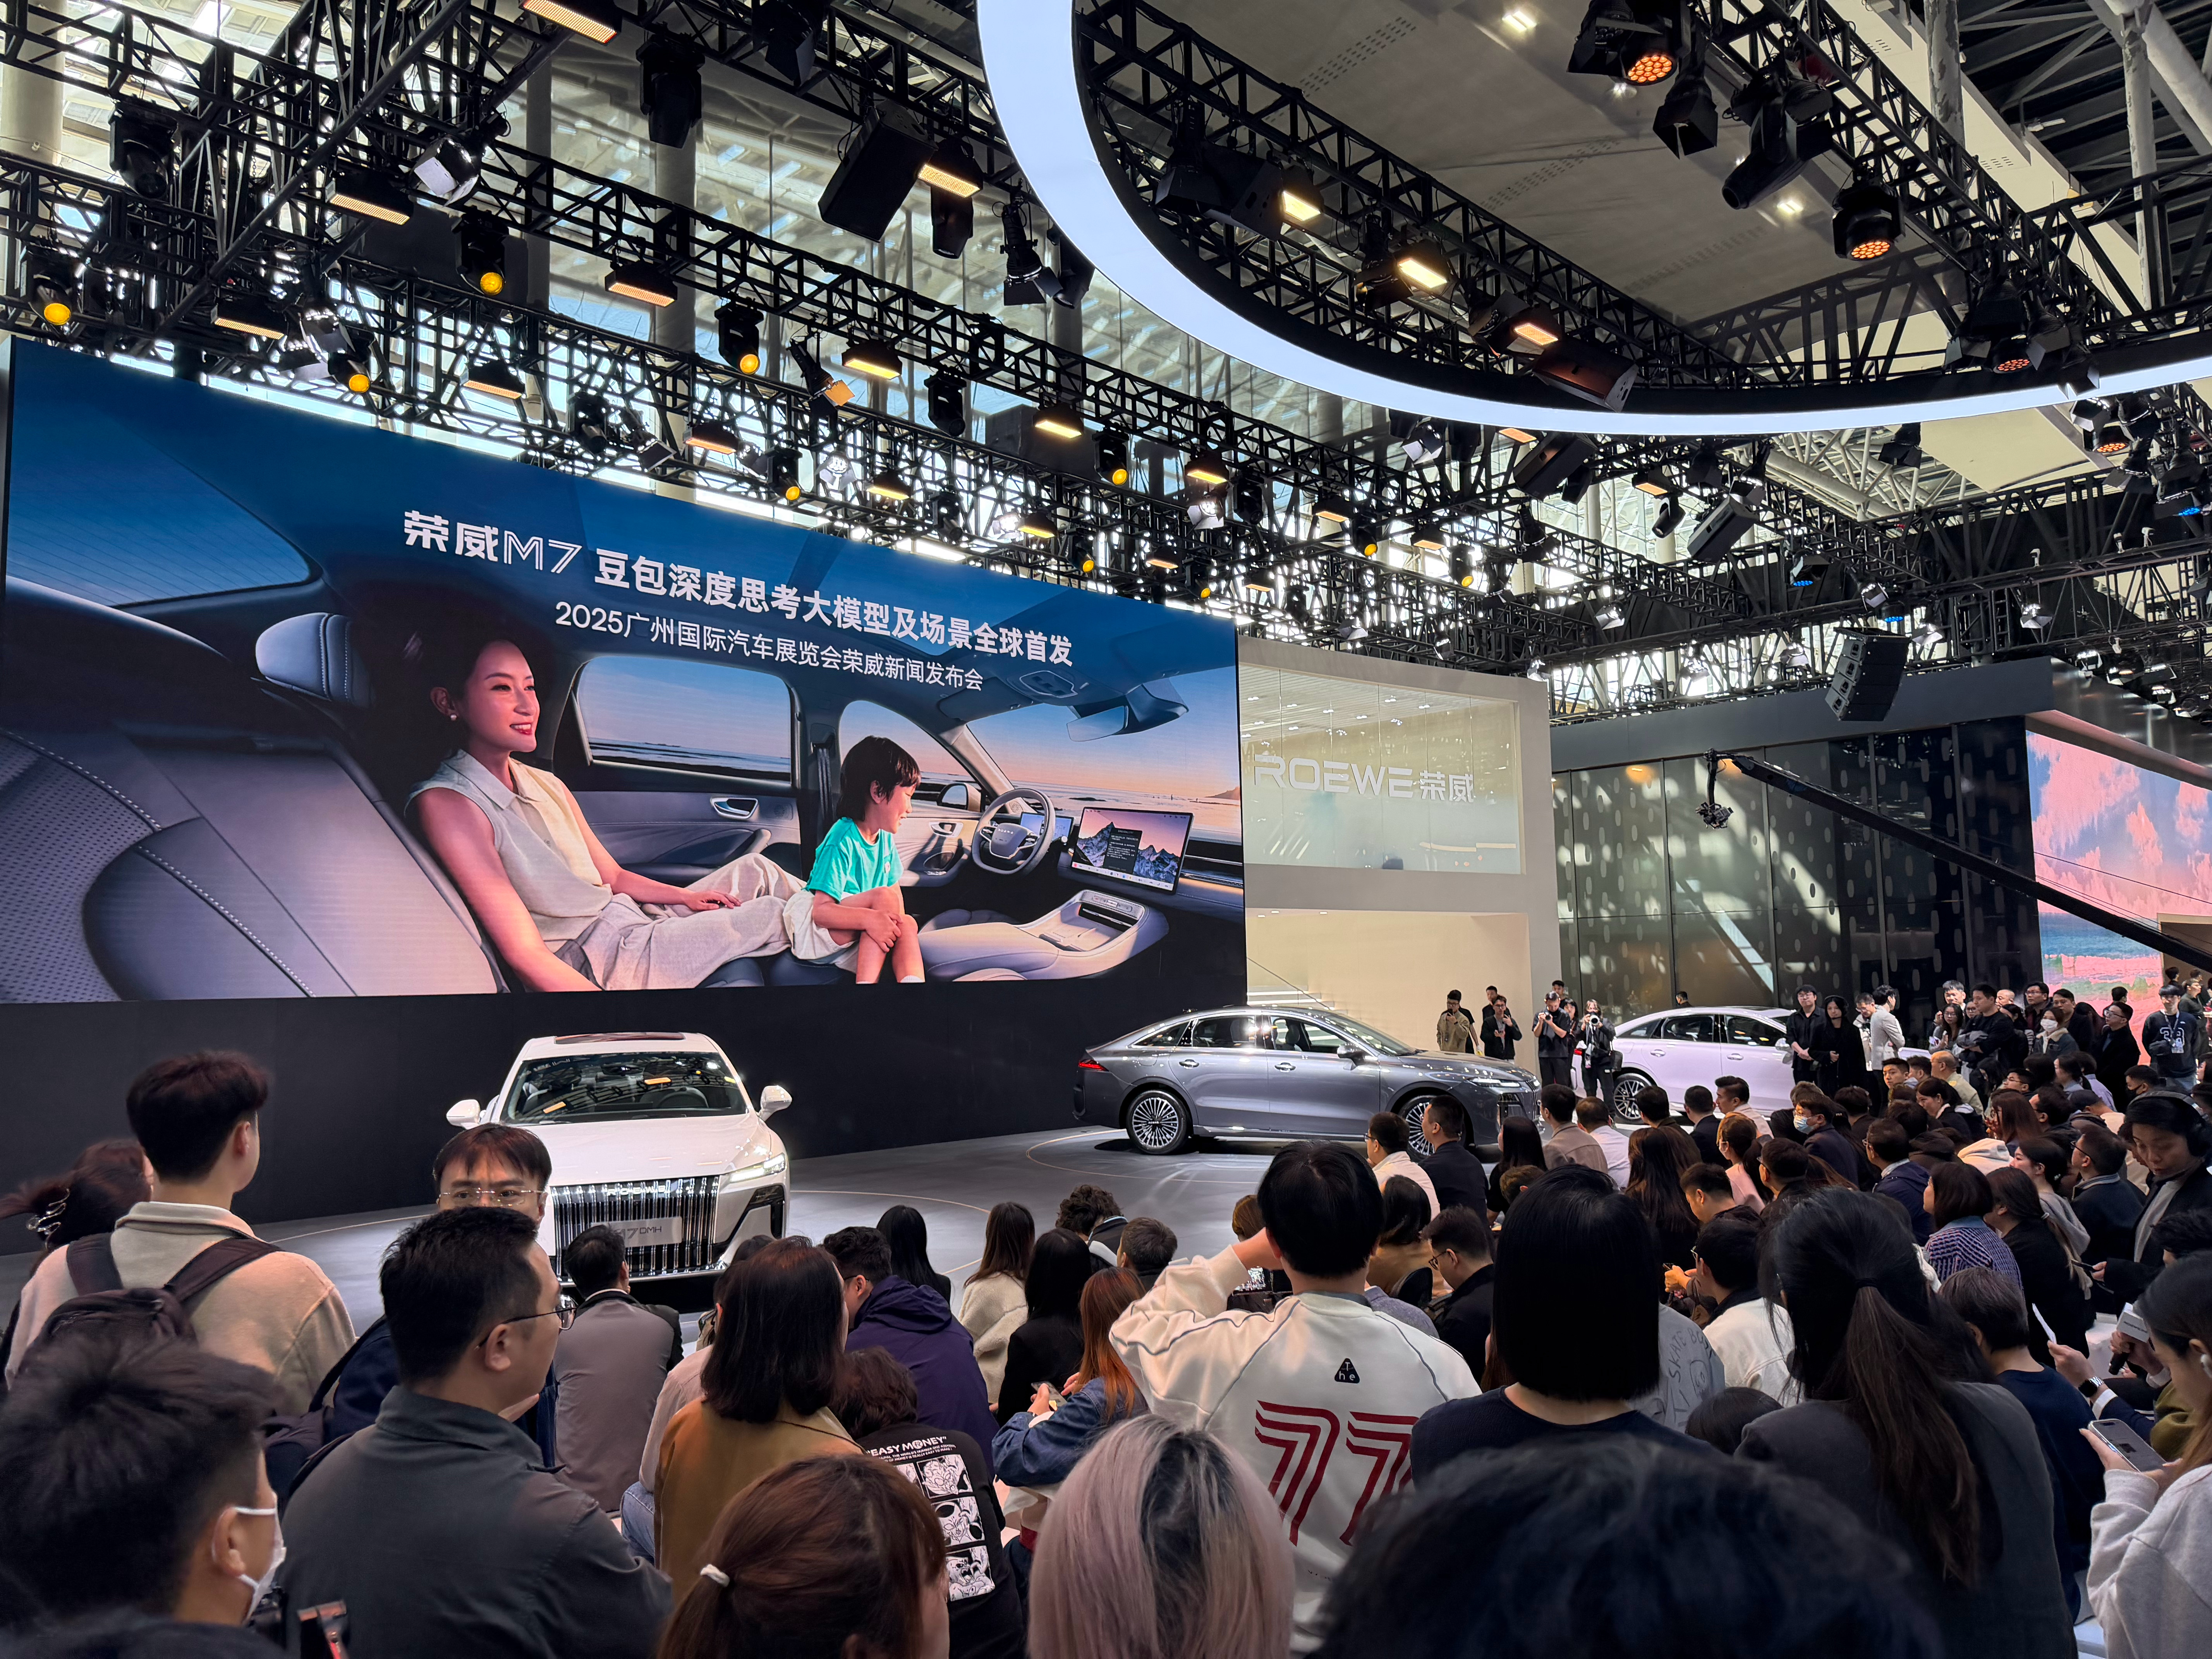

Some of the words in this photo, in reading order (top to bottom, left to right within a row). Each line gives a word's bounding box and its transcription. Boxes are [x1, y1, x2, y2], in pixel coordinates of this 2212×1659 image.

[405, 510, 582, 574] 荣威M7
[595, 548, 1072, 666] 豆包深度思考大模型及场景全球首发
[555, 601, 983, 691] 2025广州国际汽车展览会荣威新闻发布会
[1254, 754, 1413, 799] ROEWE
[1419, 770, 1474, 802] 荣威
[607, 1185, 666, 1196] ROEWE
[640, 1226, 662, 1234] DMH
[1668, 1331, 1687, 1383] SKATE
[1255, 1400, 1419, 1547] 77
